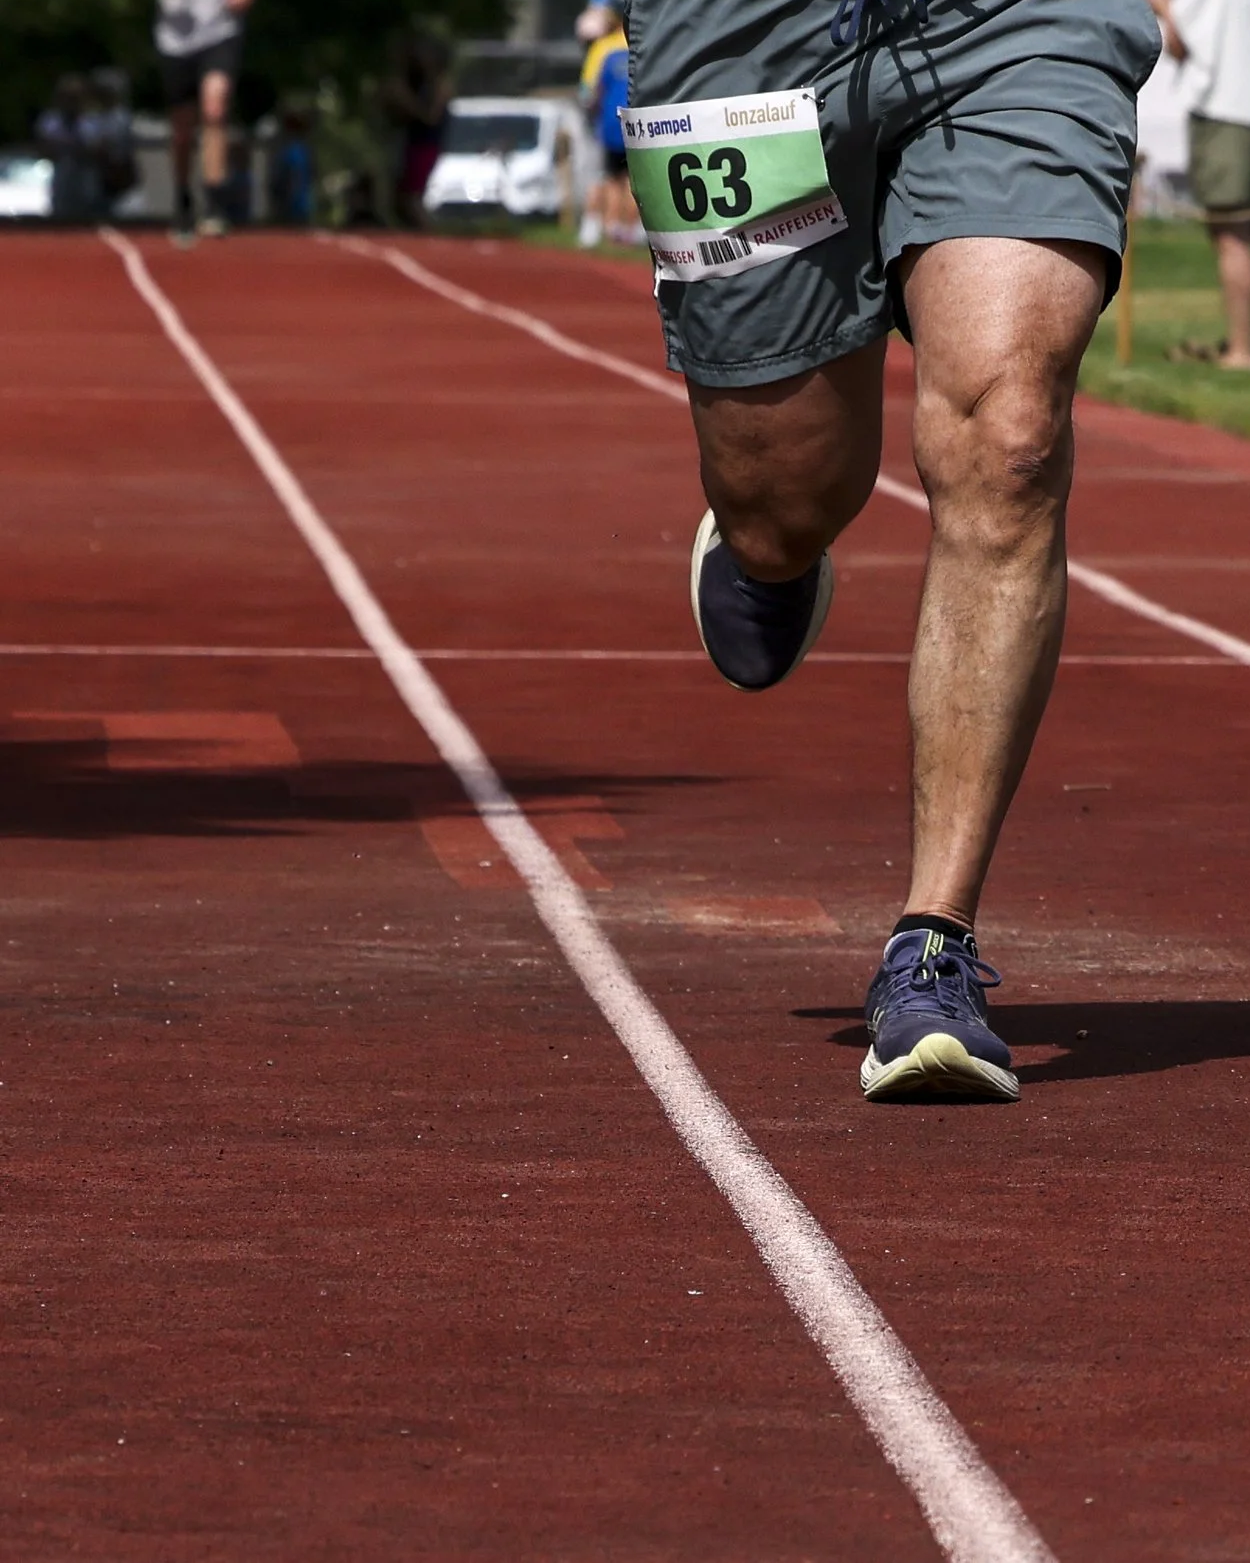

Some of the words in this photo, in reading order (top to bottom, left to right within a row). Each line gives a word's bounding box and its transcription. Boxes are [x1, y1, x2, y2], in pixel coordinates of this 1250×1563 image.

[647, 114, 693, 138] gampel
[724, 99, 797, 127] lonzalauf
[667, 147, 753, 223] 63
[753, 203, 836, 246] RAIFFEISEN
